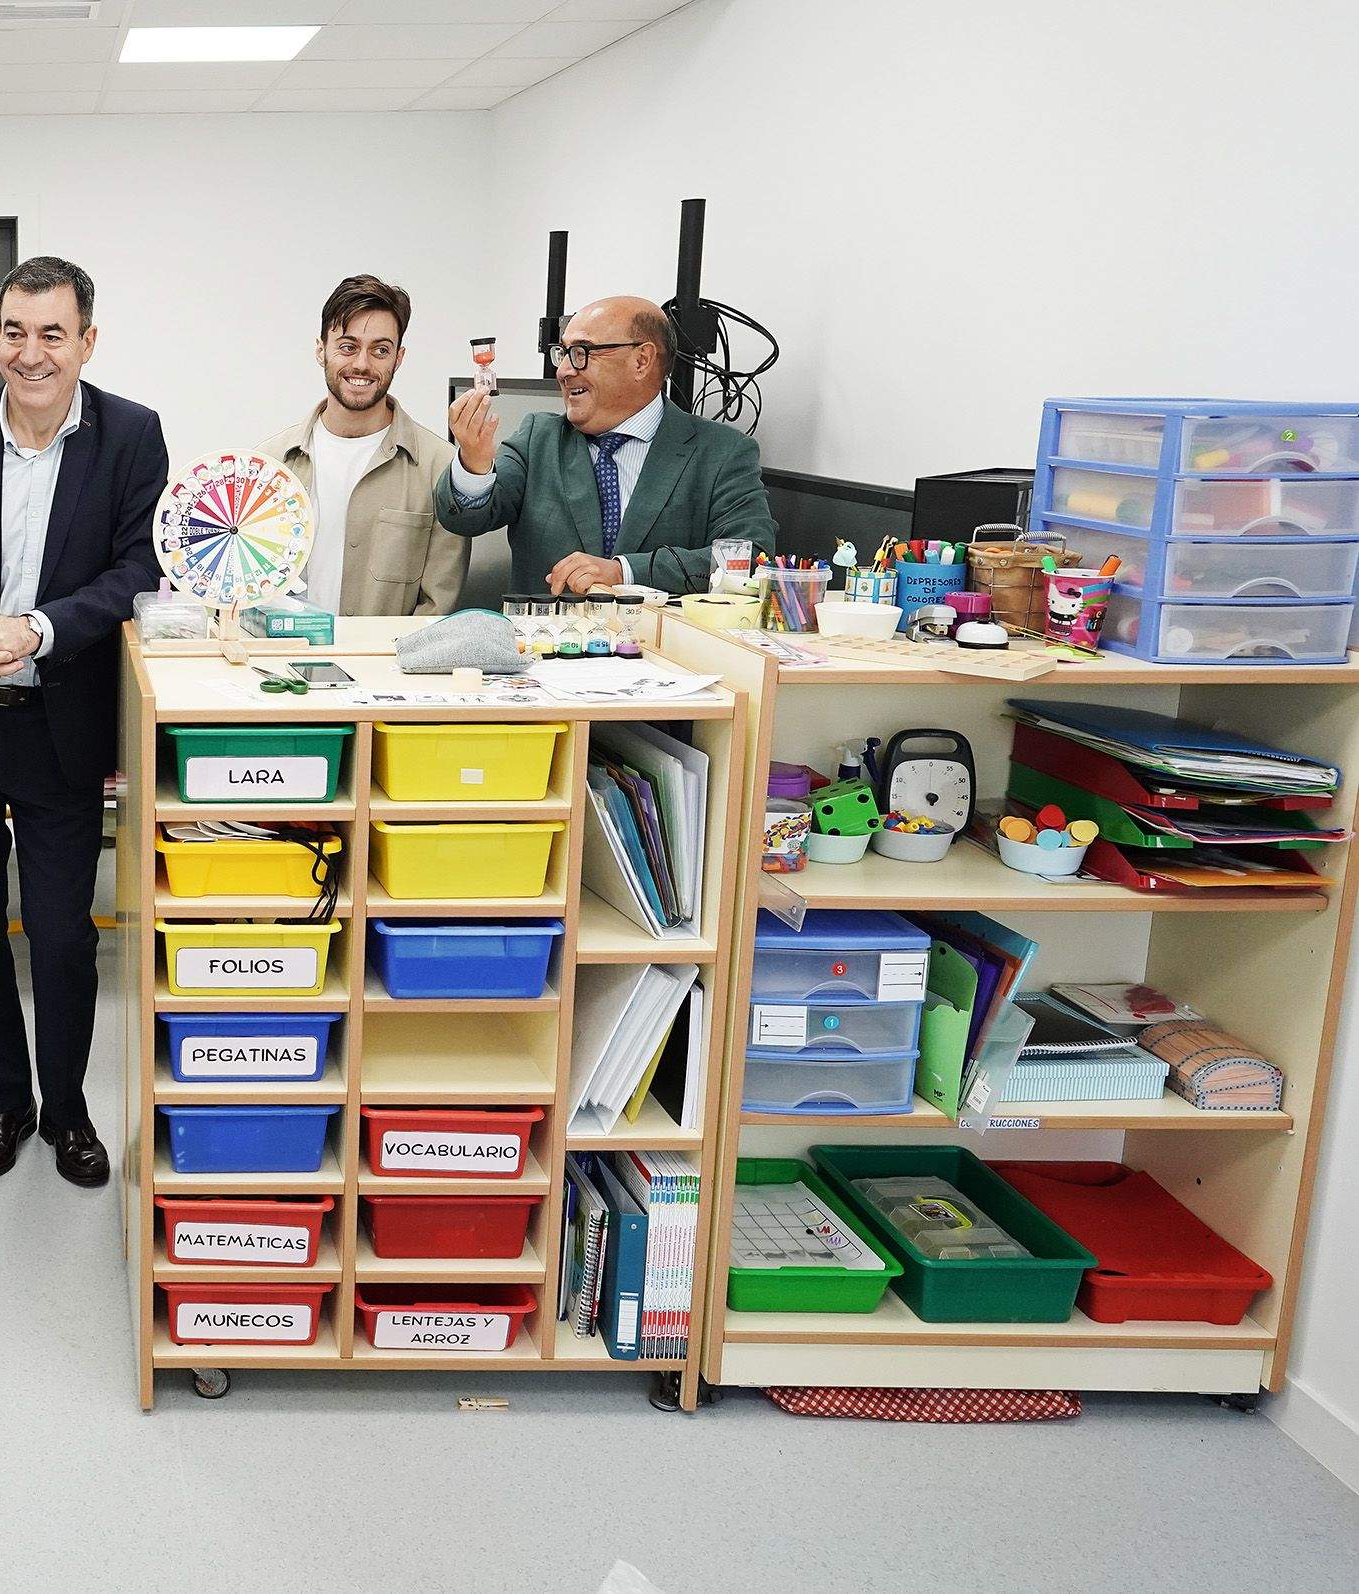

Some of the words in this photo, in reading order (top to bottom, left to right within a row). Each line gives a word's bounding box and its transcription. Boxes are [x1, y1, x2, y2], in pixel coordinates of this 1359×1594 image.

[197, 490, 207, 498] 26
[185, 506, 193, 515] 24
[182, 527, 188, 535] 22
[906, 576, 962, 586] DEPRESORES
[228, 768, 285, 784] LARA
[209, 959, 284, 974] FOLIOS
[192, 1048, 307, 1063] PEGATINAS
[960, 1120, 1039, 1128] CRUCCIONES
[384, 1142, 518, 1160] VOCABULARIO
[176, 1232, 307, 1251] MATEMÁTICAS
[193, 1312, 294, 1328] MUÑECOS
[392, 1315, 477, 1328] LENTEJAS
[482, 1317, 494, 1328] Y
[410, 1333, 471, 1345] ARROZ
